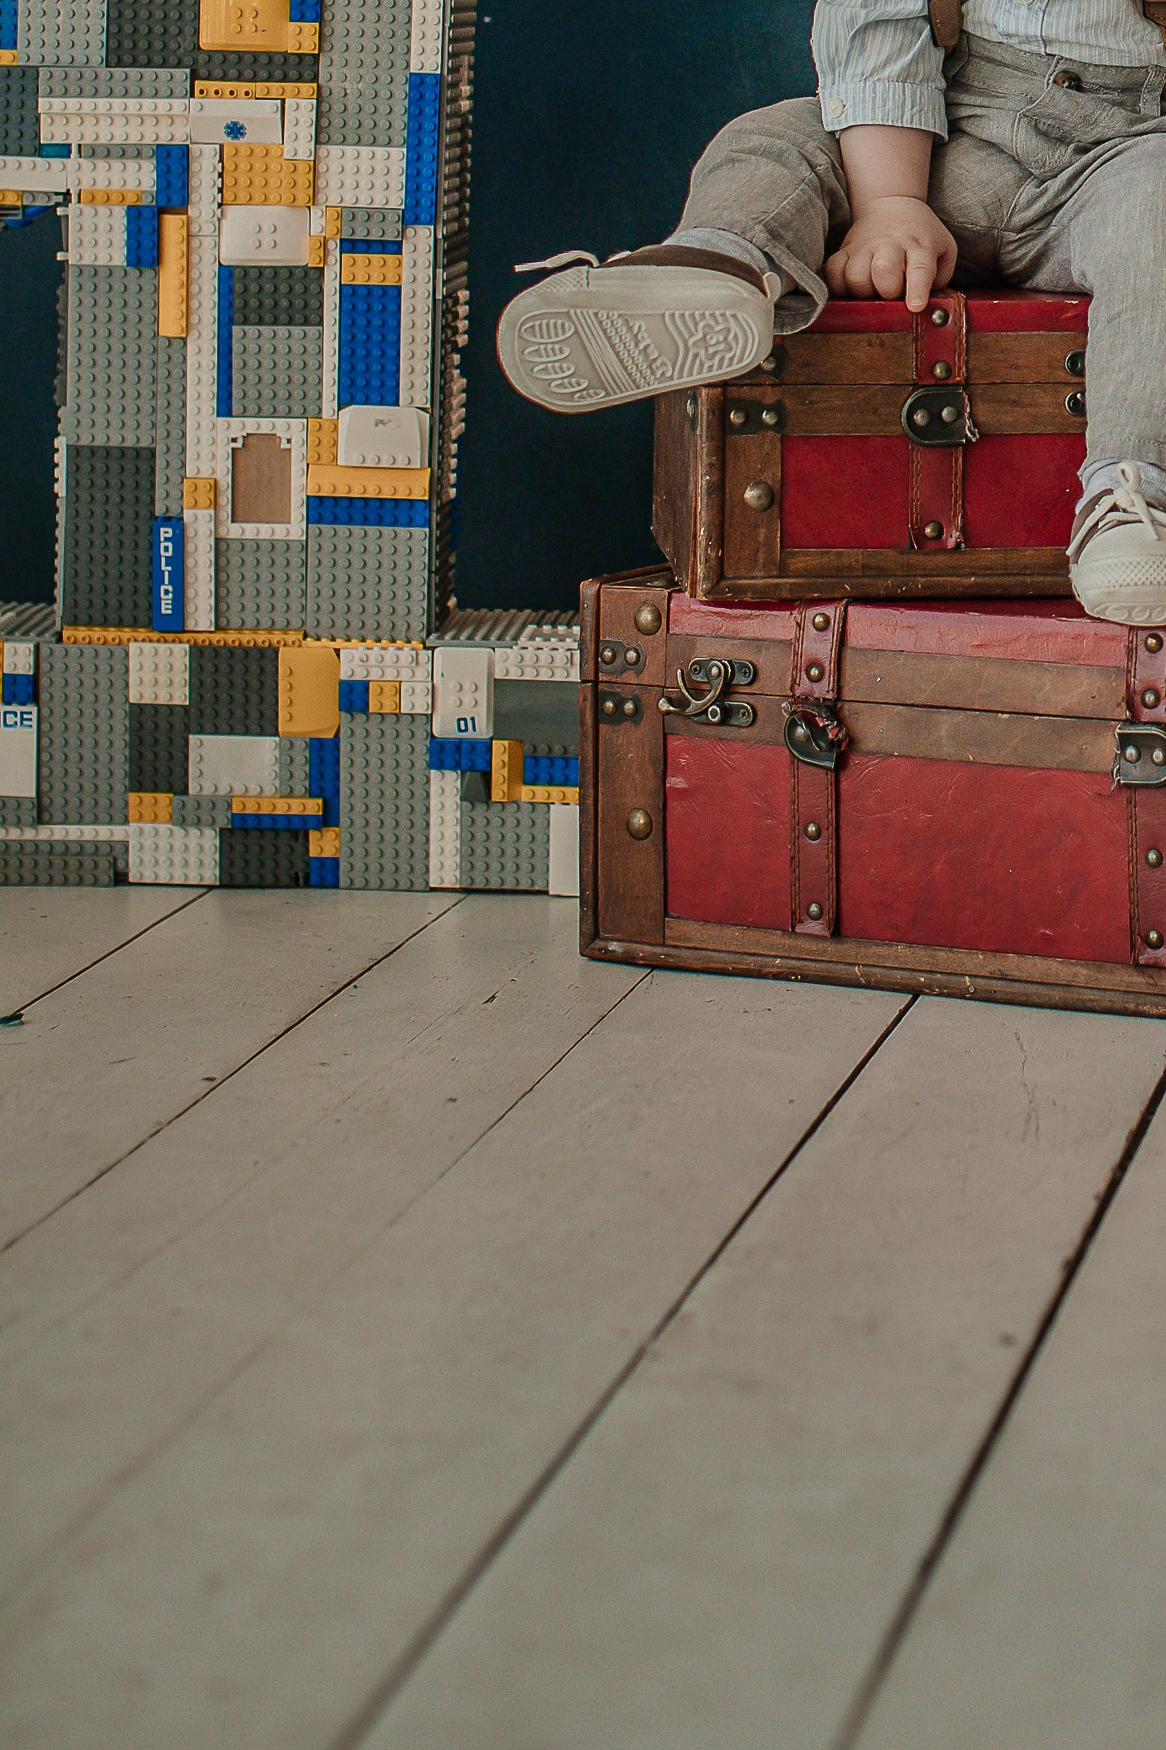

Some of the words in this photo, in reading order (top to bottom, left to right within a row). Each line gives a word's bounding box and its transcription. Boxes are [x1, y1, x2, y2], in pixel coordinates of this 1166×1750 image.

[160, 527, 173, 614] POLICE
[0, 710, 33, 729] CE
[456, 716, 477, 733] 01
